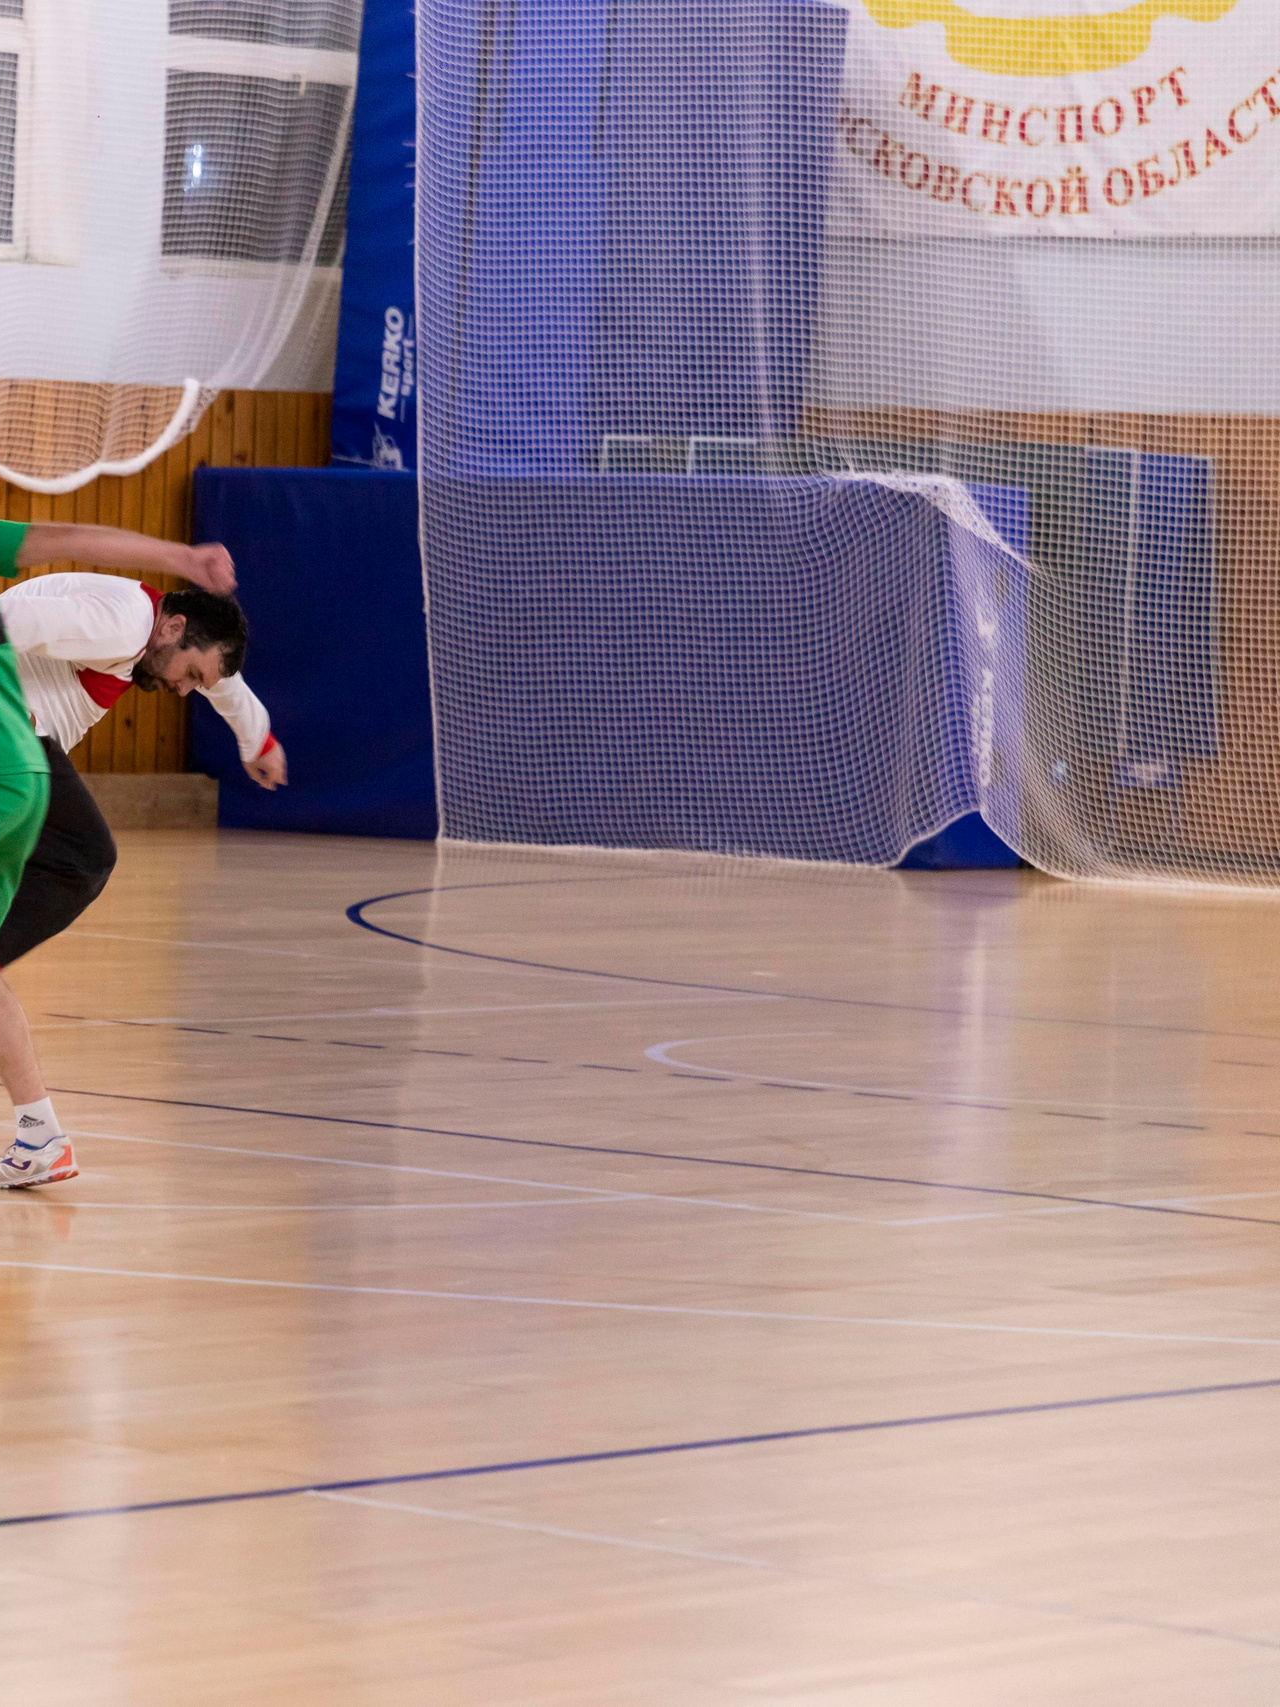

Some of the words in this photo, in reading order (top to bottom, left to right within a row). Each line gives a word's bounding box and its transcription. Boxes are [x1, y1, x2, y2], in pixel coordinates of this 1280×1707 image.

[898, 66, 1190, 147] МИНСПОРТ
[1103, 66, 1280, 206] ОБЛАСТ
[377, 306, 404, 420] KERKO
[401, 338, 415, 397] sport
